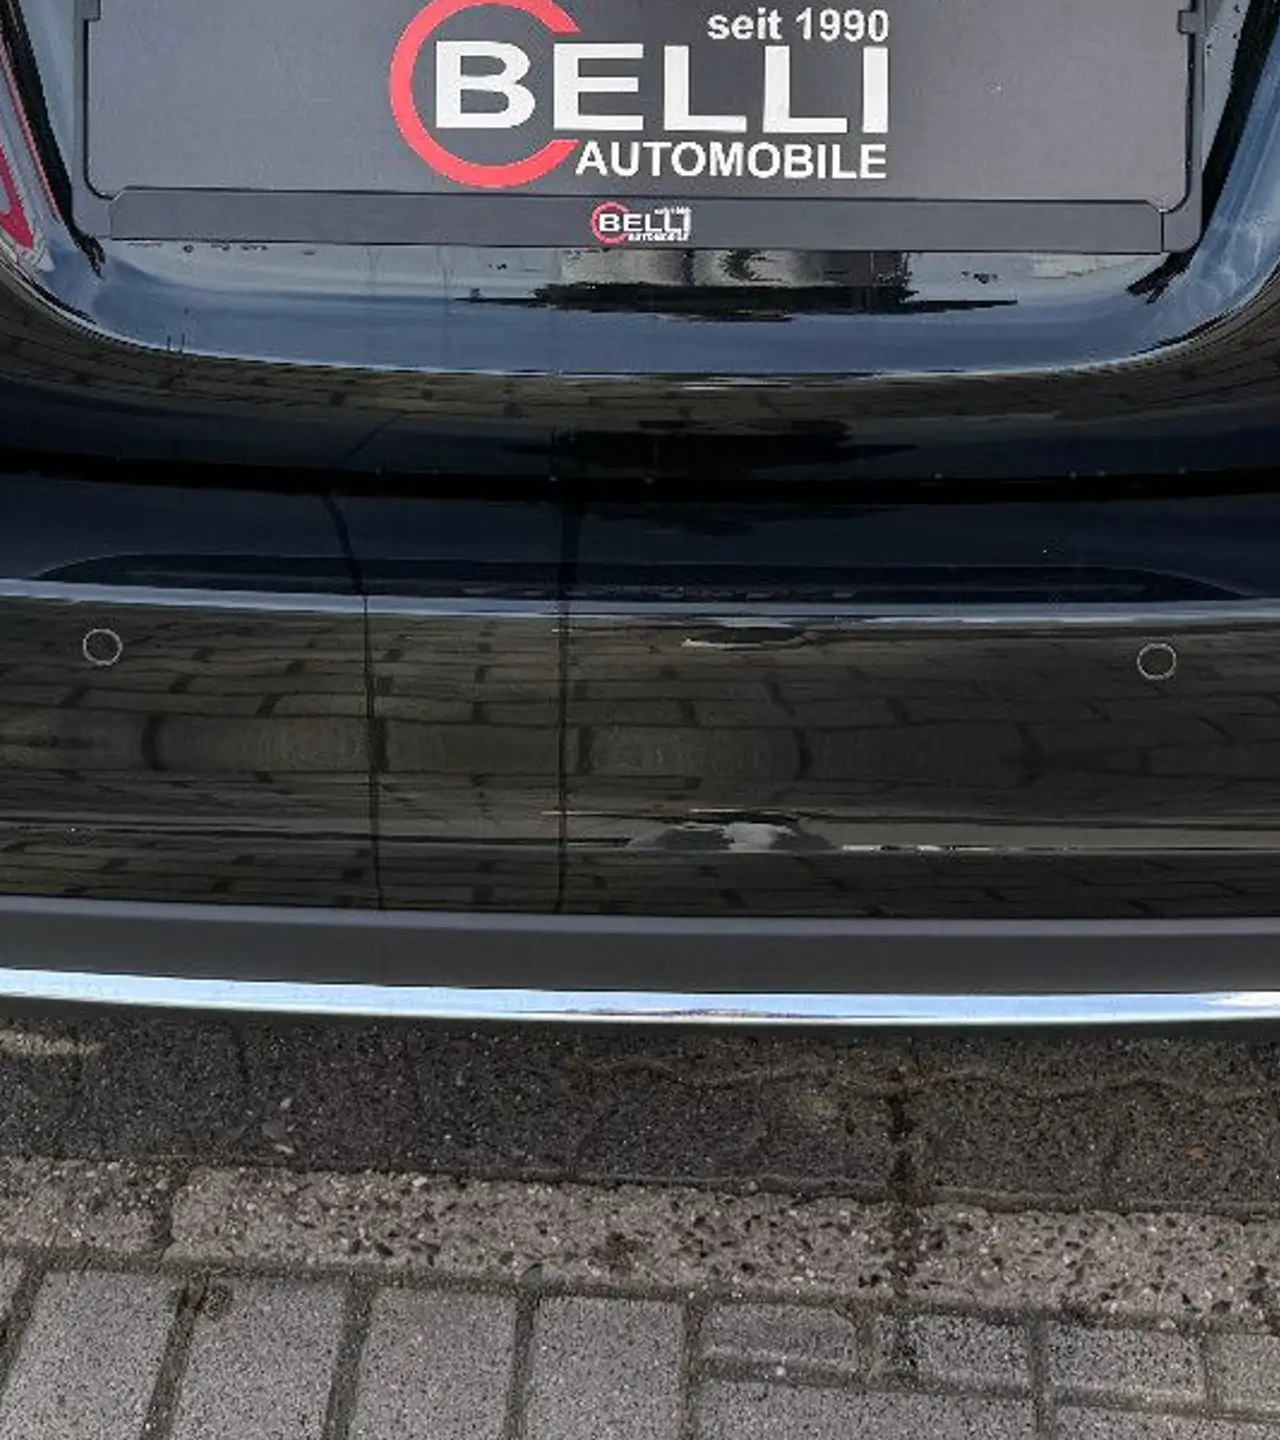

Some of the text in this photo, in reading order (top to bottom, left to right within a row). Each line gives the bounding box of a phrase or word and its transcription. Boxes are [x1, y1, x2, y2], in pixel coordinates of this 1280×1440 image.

[707, 6, 890, 42] seit 1990
[435, 40, 889, 134] BELLI
[575, 140, 887, 180] AUTOMOBILE
[599, 212, 692, 233] BELLI
